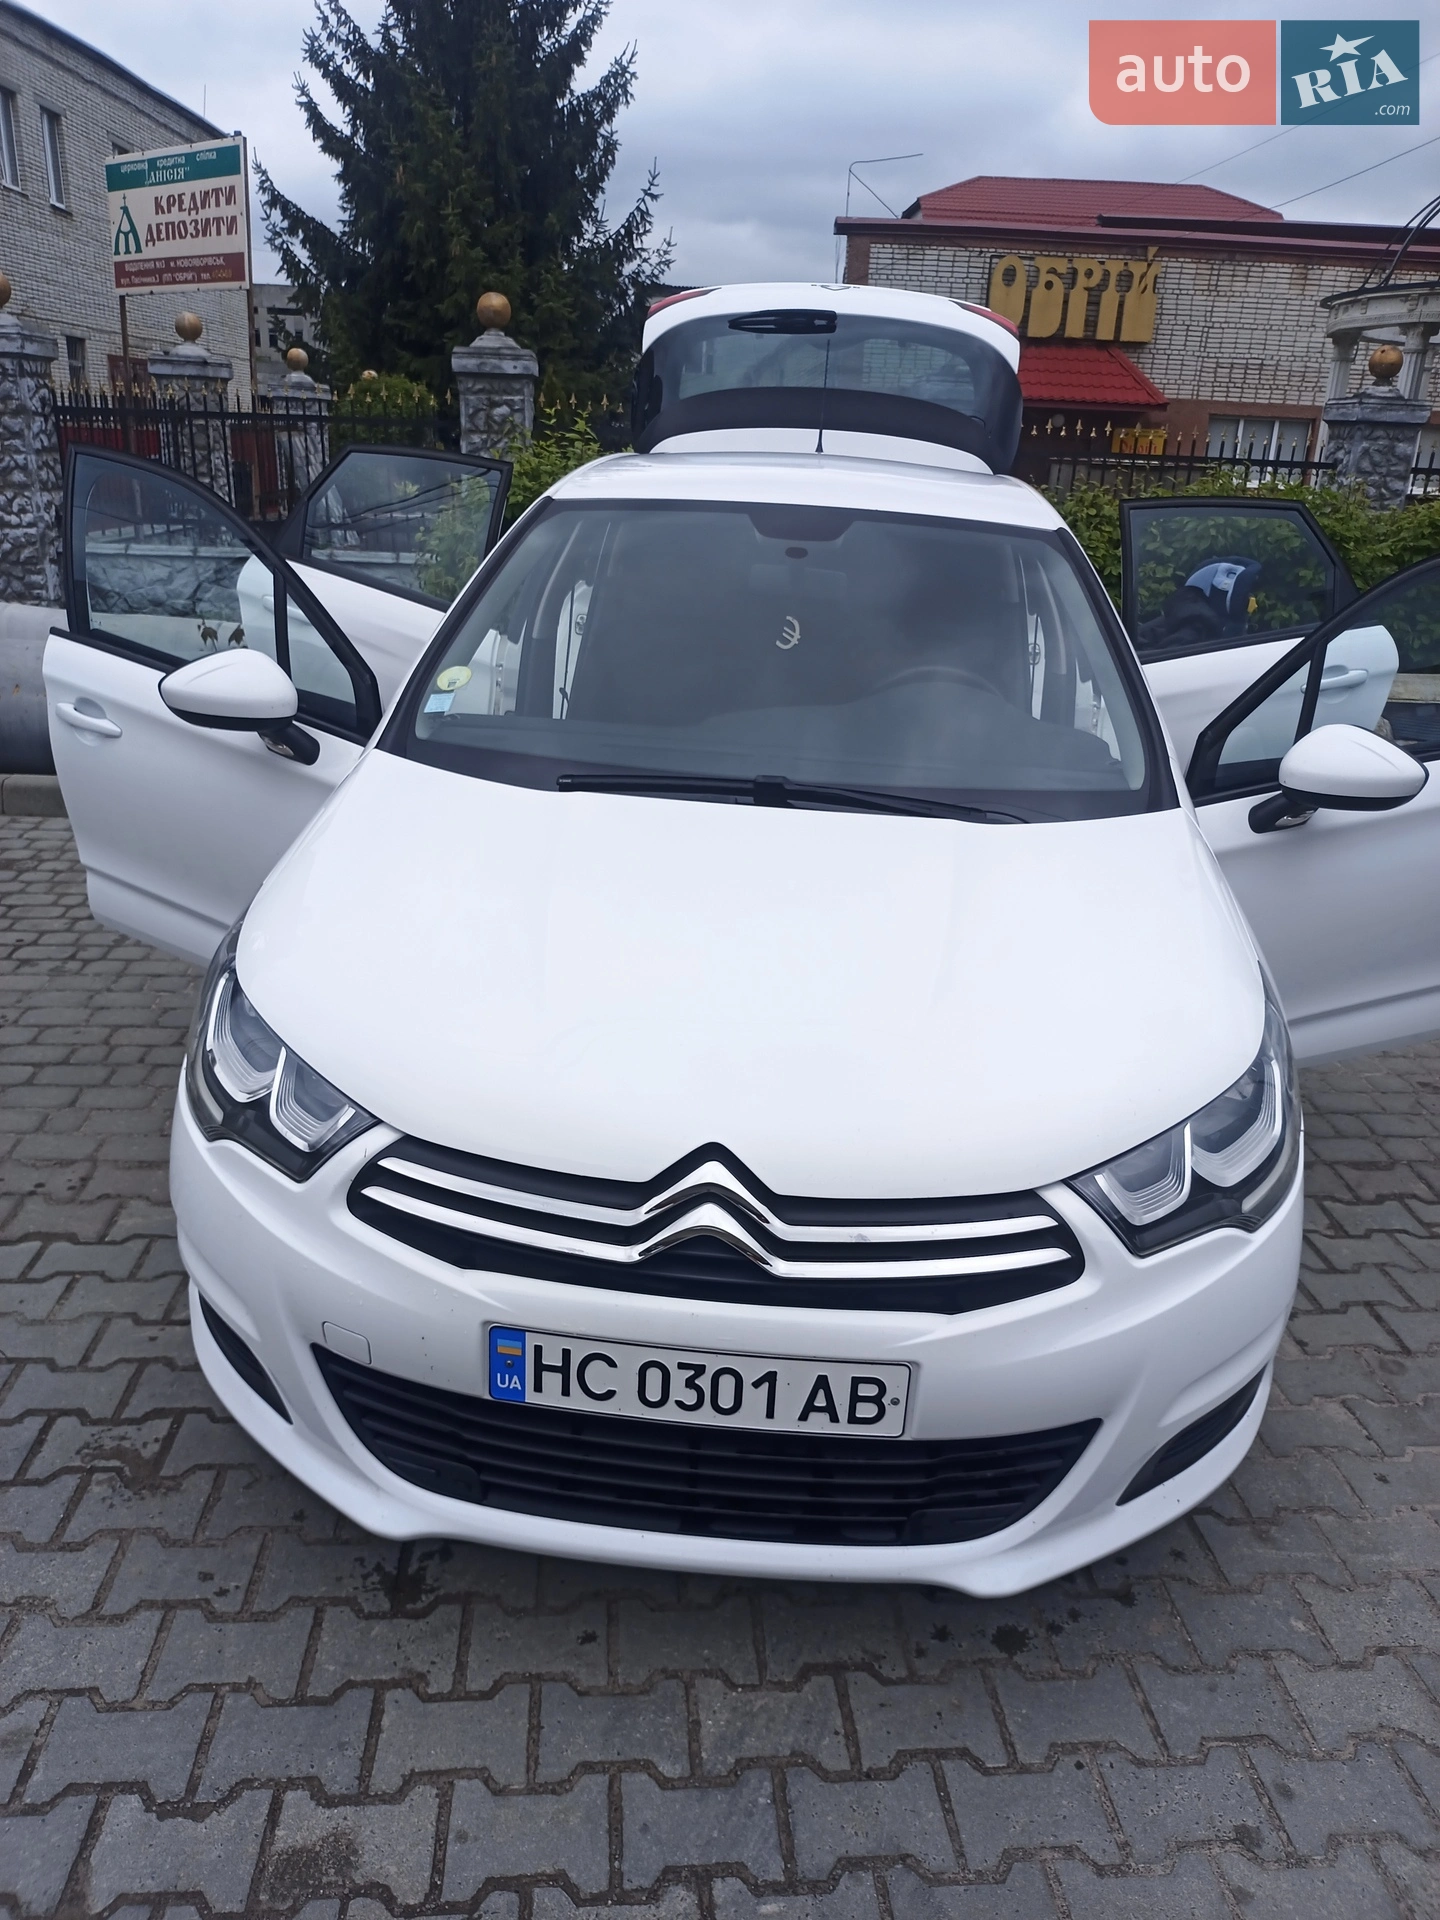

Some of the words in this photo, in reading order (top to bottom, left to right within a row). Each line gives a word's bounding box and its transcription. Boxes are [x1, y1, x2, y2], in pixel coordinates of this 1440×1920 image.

[120, 161, 148, 174] церковна
[156, 155, 185, 169] кредитна
[195, 150, 217, 162] спілка
[154, 185, 237, 217] КРЕДИТИ
[144, 215, 238, 248] ДЕПОЗИТИ
[988, 246, 1162, 344] ОБРІЙ
[496, 1372, 522, 1391] UA
[531, 1343, 619, 1401] HC
[636, 1360, 778, 1420] 0301
[796, 1374, 888, 1425] AB
